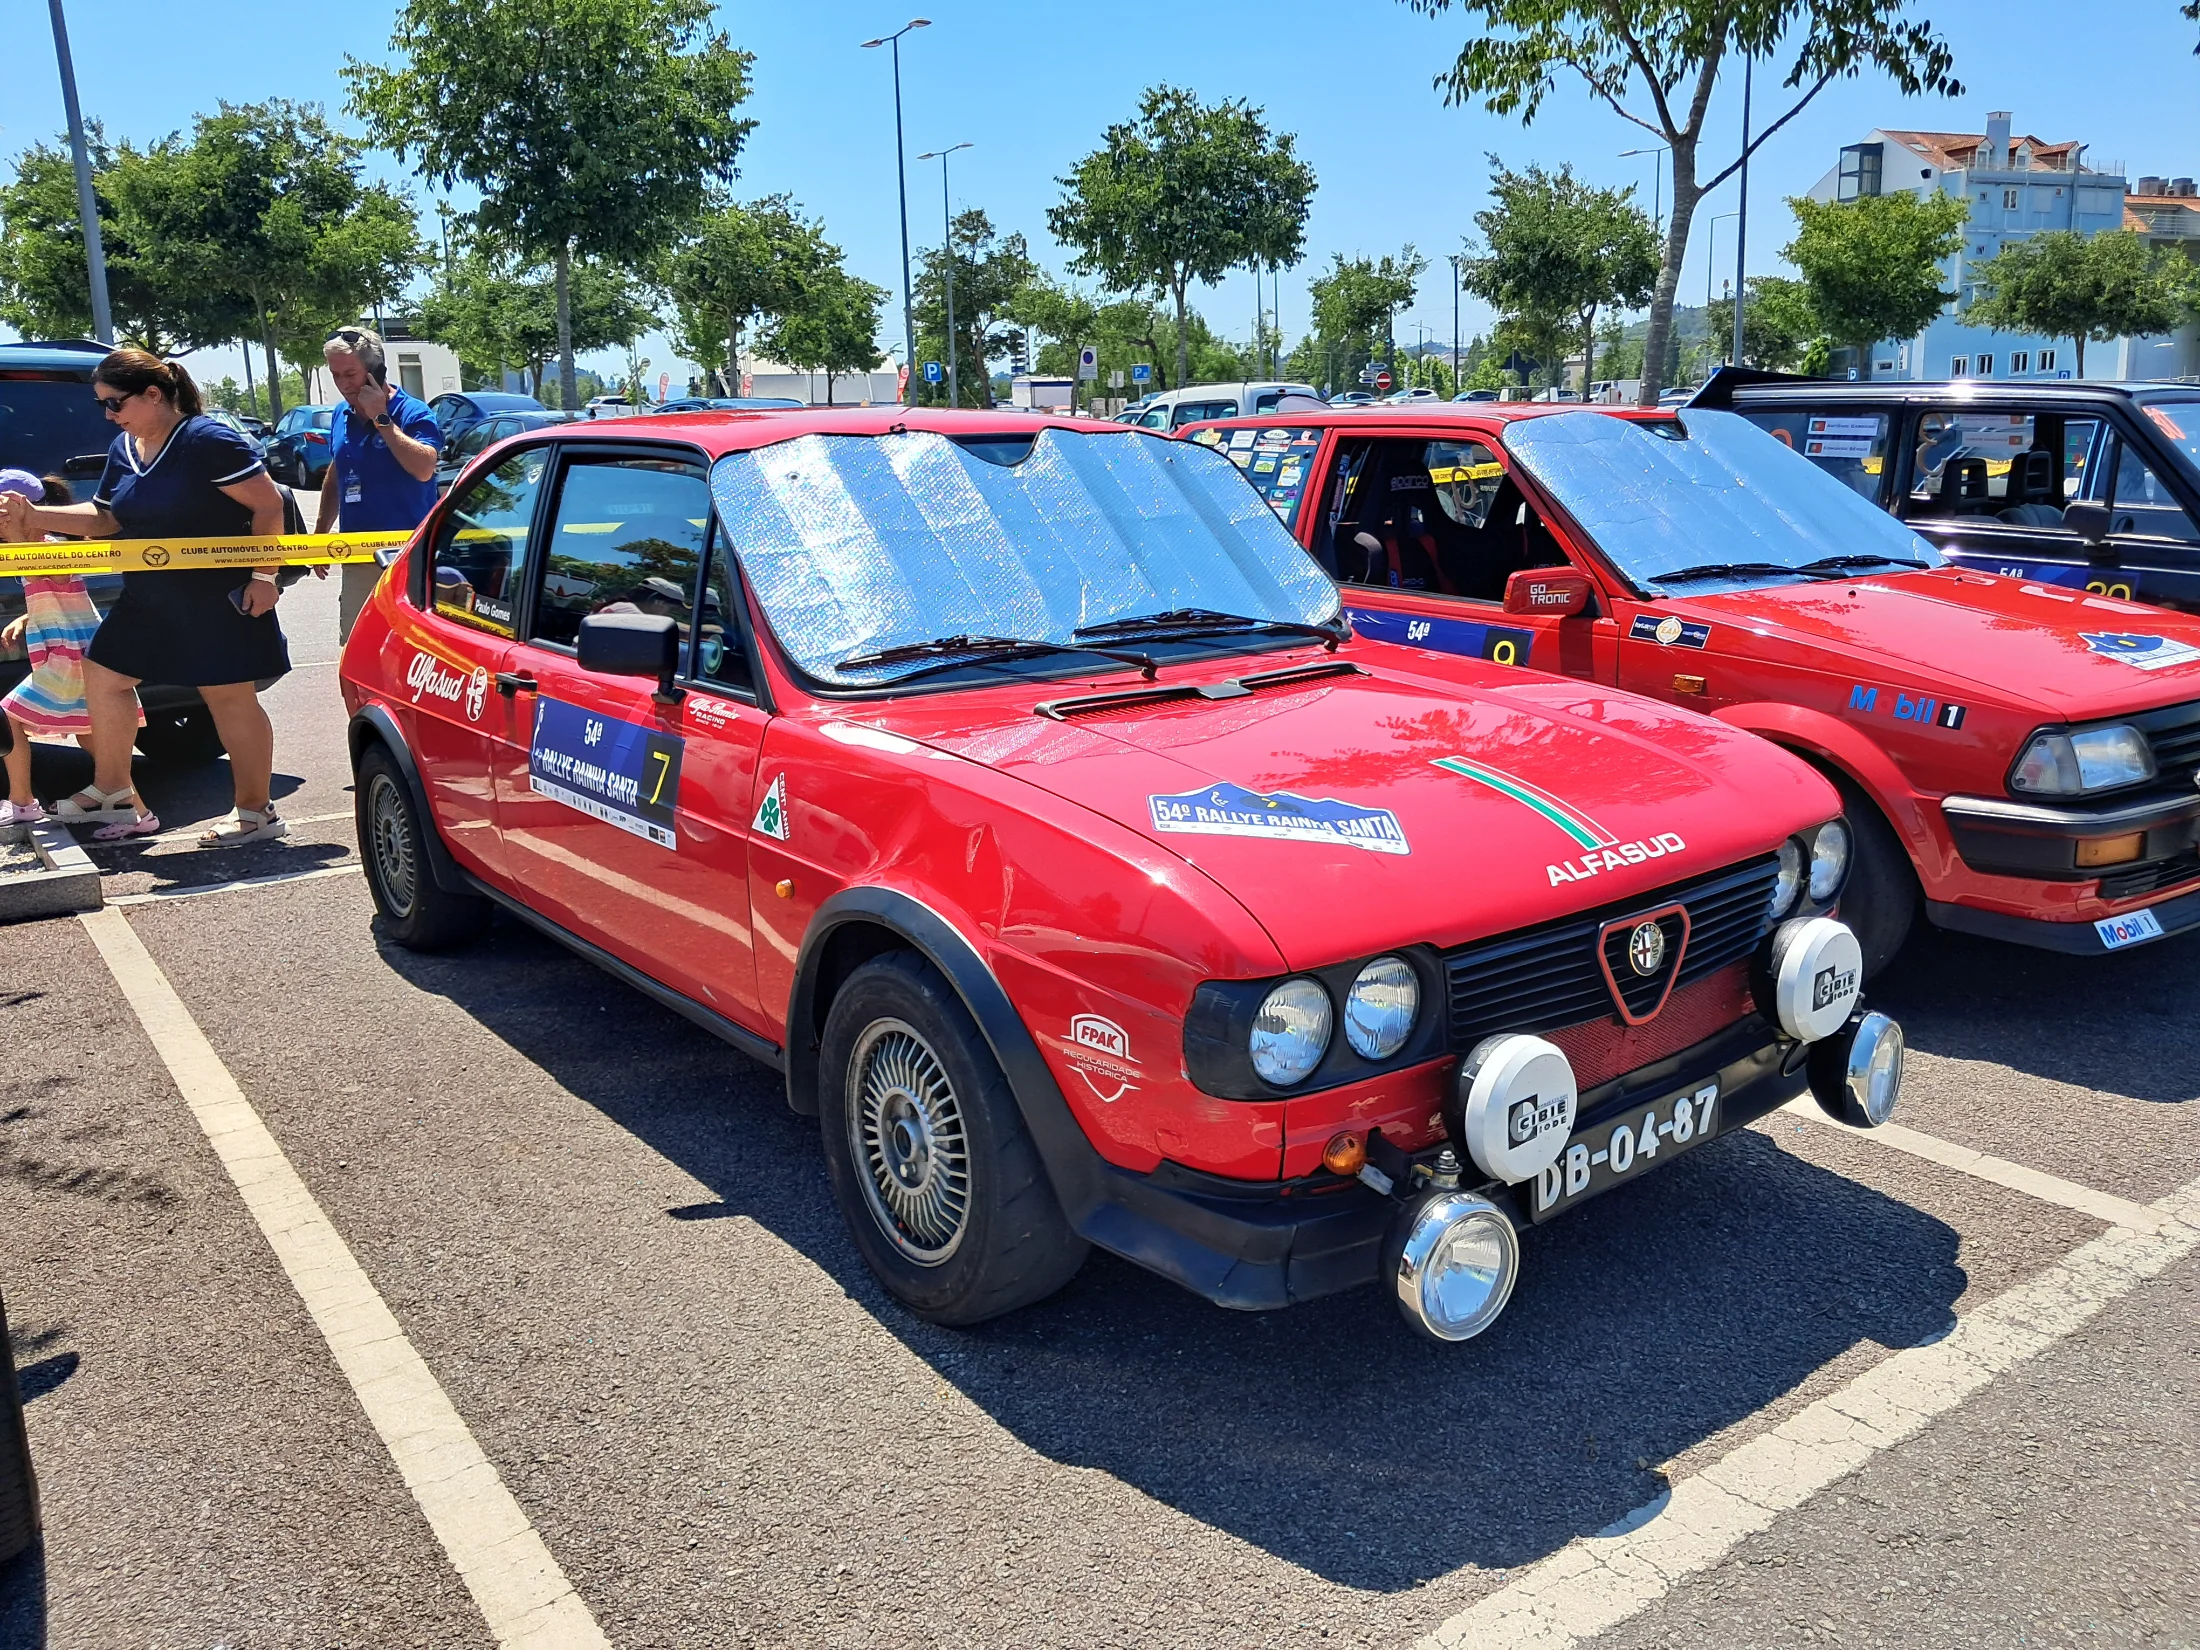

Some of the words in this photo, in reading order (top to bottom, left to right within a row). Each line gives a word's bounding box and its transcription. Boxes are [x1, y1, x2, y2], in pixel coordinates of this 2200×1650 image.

[927, 363, 938, 379] P
[1134, 367, 1143, 378] P
[181, 546, 209, 555] CLUBE
[210, 544, 261, 554] AUTOMÓVEL
[276, 544, 309, 552] CENTRO
[360, 540, 386, 548] CLUBE
[14, 550, 69, 561] AUTOMÓVEL
[71, 551, 84, 559] DO
[86, 550, 122, 558] CENTRO
[214, 556, 282, 565] www.cacsport.com
[1530, 583, 1546, 595] GO
[1530, 593, 1571, 605] TRONIC
[474, 599, 491, 615] Paulo
[490, 604, 511, 622] Gomes
[1407, 620, 1431, 642] 54ª
[1658, 625, 1680, 635] TEAM
[688, 697, 713, 715] Alfa
[712, 702, 742, 720] Romeo
[696, 711, 726, 725] RACING
[1946, 705, 1960, 727] 1
[584, 718, 603, 748] 54ª
[541, 747, 572, 782] RALLYE
[572, 759, 607, 796] RAINHA
[606, 771, 639, 808] SANTA
[649, 750, 671, 805] 7
[779, 772, 787, 807] CENT
[781, 809, 791, 840] ANNI
[1194, 806, 1265, 825] RALLYE
[1336, 815, 1401, 840] SANTA
[1545, 832, 1687, 887] ALFASUD
[2100, 917, 2145, 945] Mobil
[1833, 986, 1855, 1001] IODE
[1080, 1025, 1119, 1050] FPAK
[1063, 1048, 1141, 1079] REGULARIDADE
[1076, 1061, 1128, 1083] HISTORICA
[1539, 1114, 1567, 1134] IODE
[1538, 1084, 1719, 1213] DB-04-87
